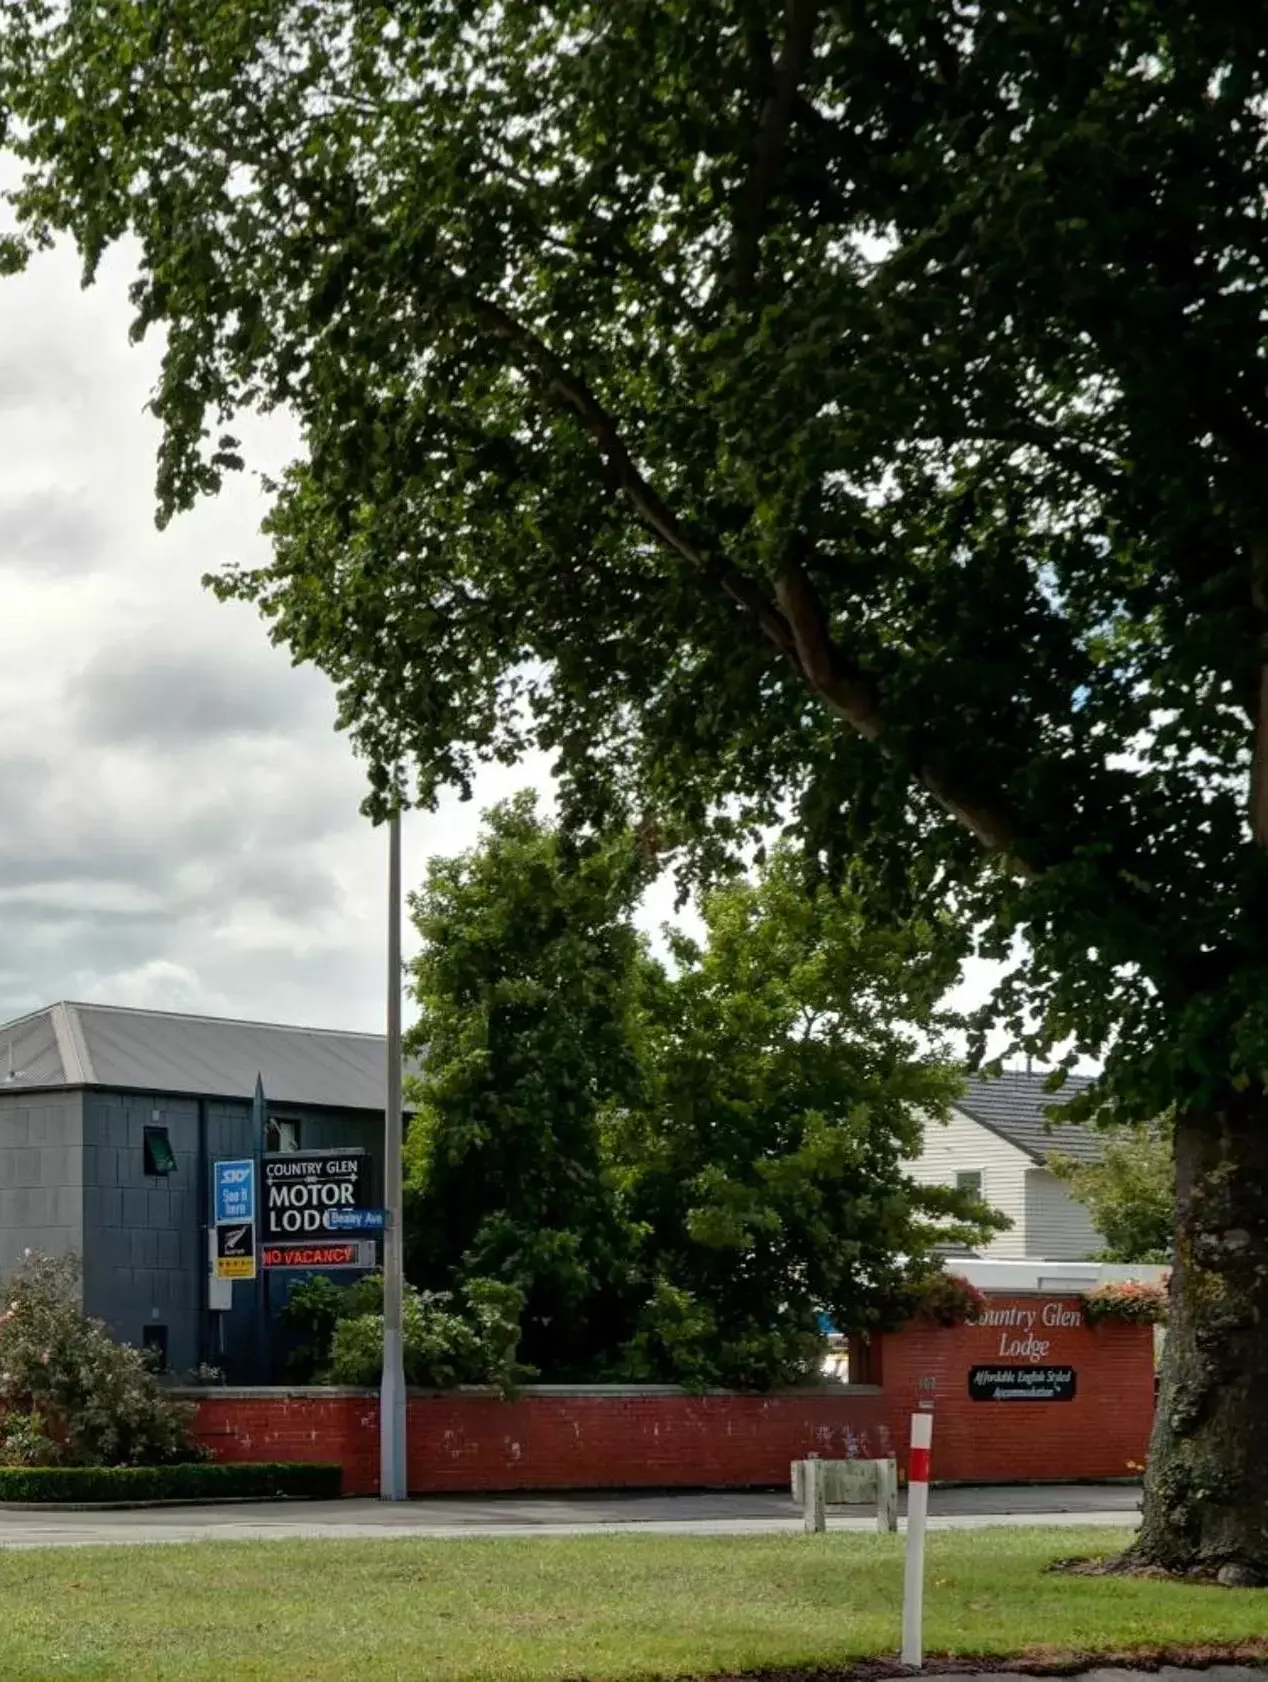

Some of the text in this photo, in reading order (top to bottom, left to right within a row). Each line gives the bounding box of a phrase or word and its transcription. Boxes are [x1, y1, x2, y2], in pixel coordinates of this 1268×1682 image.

[221, 1169, 250, 1183] SKY
[266, 1161, 358, 1176] COUNTRY GLEN
[269, 1183, 355, 1207] MOTOR
[364, 1212, 383, 1225] Ave
[263, 1250, 281, 1264] NO
[285, 1247, 352, 1264] VACANCY
[1042, 1302, 1082, 1327] Glen
[998, 1333, 1050, 1363] Lodge
